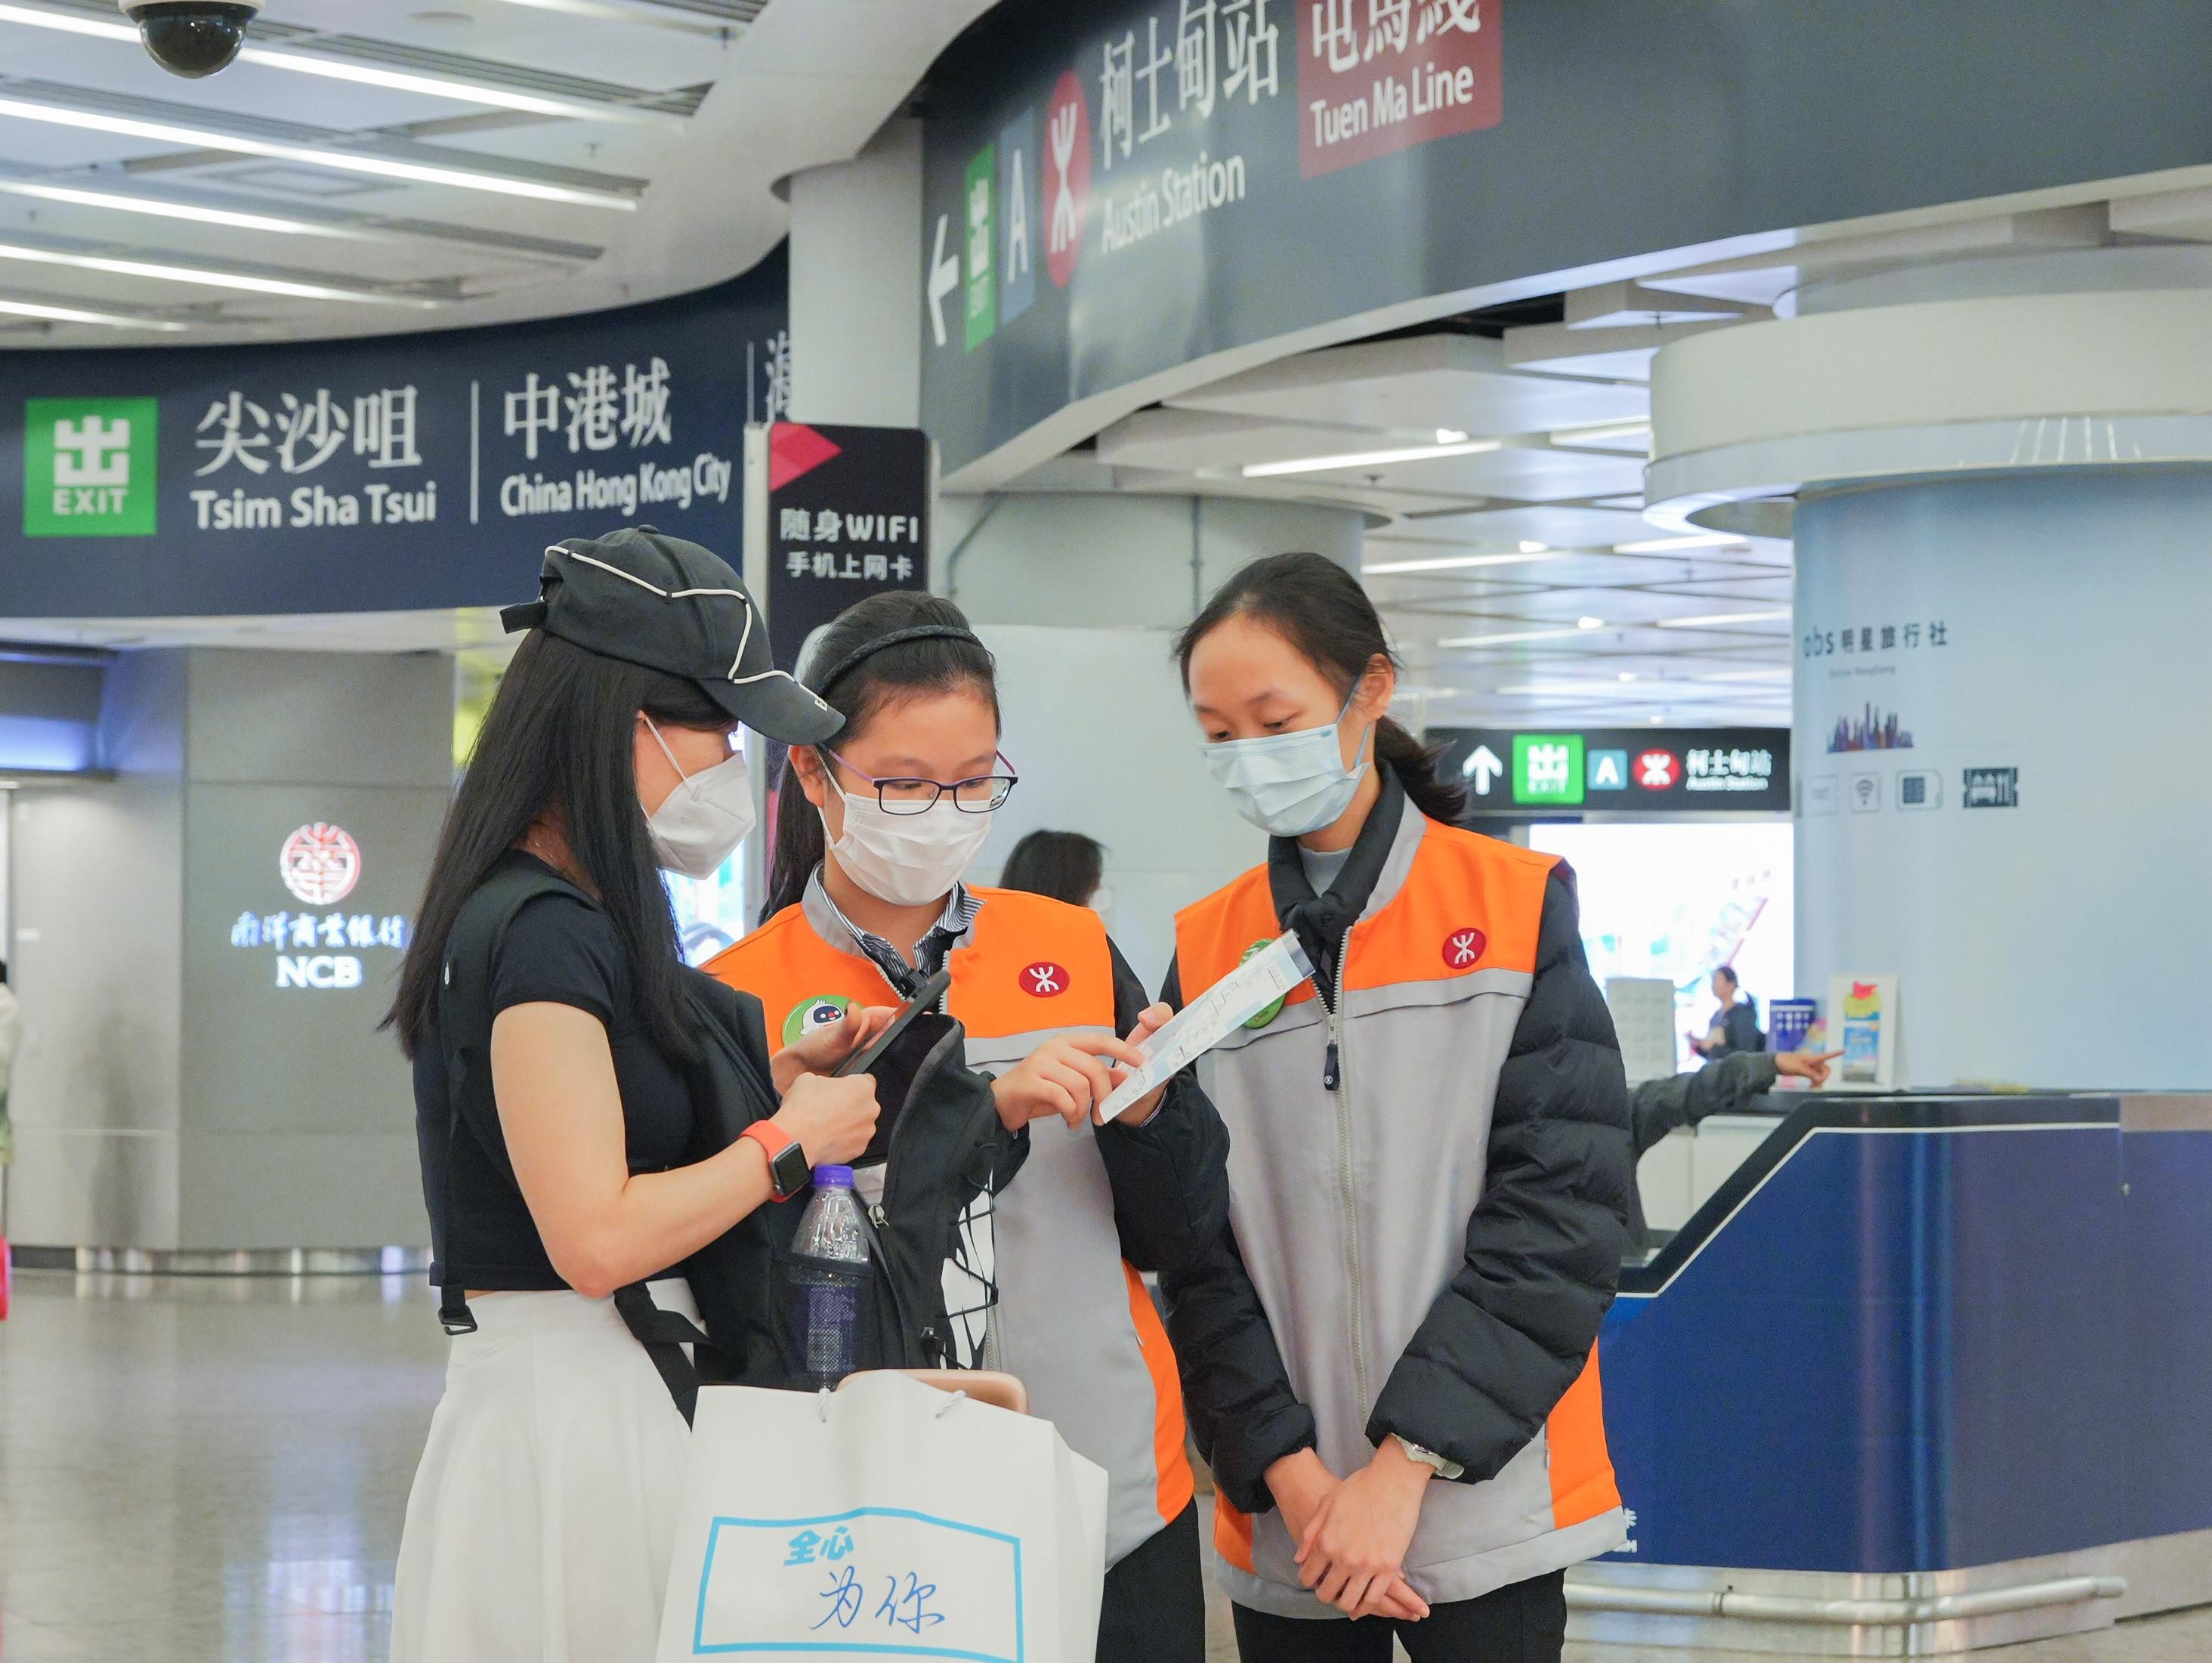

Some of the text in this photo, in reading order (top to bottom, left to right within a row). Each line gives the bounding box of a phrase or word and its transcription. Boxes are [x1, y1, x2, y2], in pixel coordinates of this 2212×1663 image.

[1099, 0, 1279, 171] 柯士甸站
[1310, 61, 1474, 147] Tuen Ma Line
[1007, 150, 1028, 283] A
[1101, 150, 1246, 254] Austin Station
[195, 385, 422, 477] 尖沙咀
[504, 356, 672, 459] 中港城
[53, 489, 128, 515] EXIT
[190, 481, 437, 530] Tsim Sha Tsui
[500, 452, 732, 517] China Hong Kong City
[786, 551, 914, 581] 手机上网卡
[1596, 756, 1619, 784] A
[275, 955, 363, 988] NCB
[783, 1525, 854, 1566] 全心
